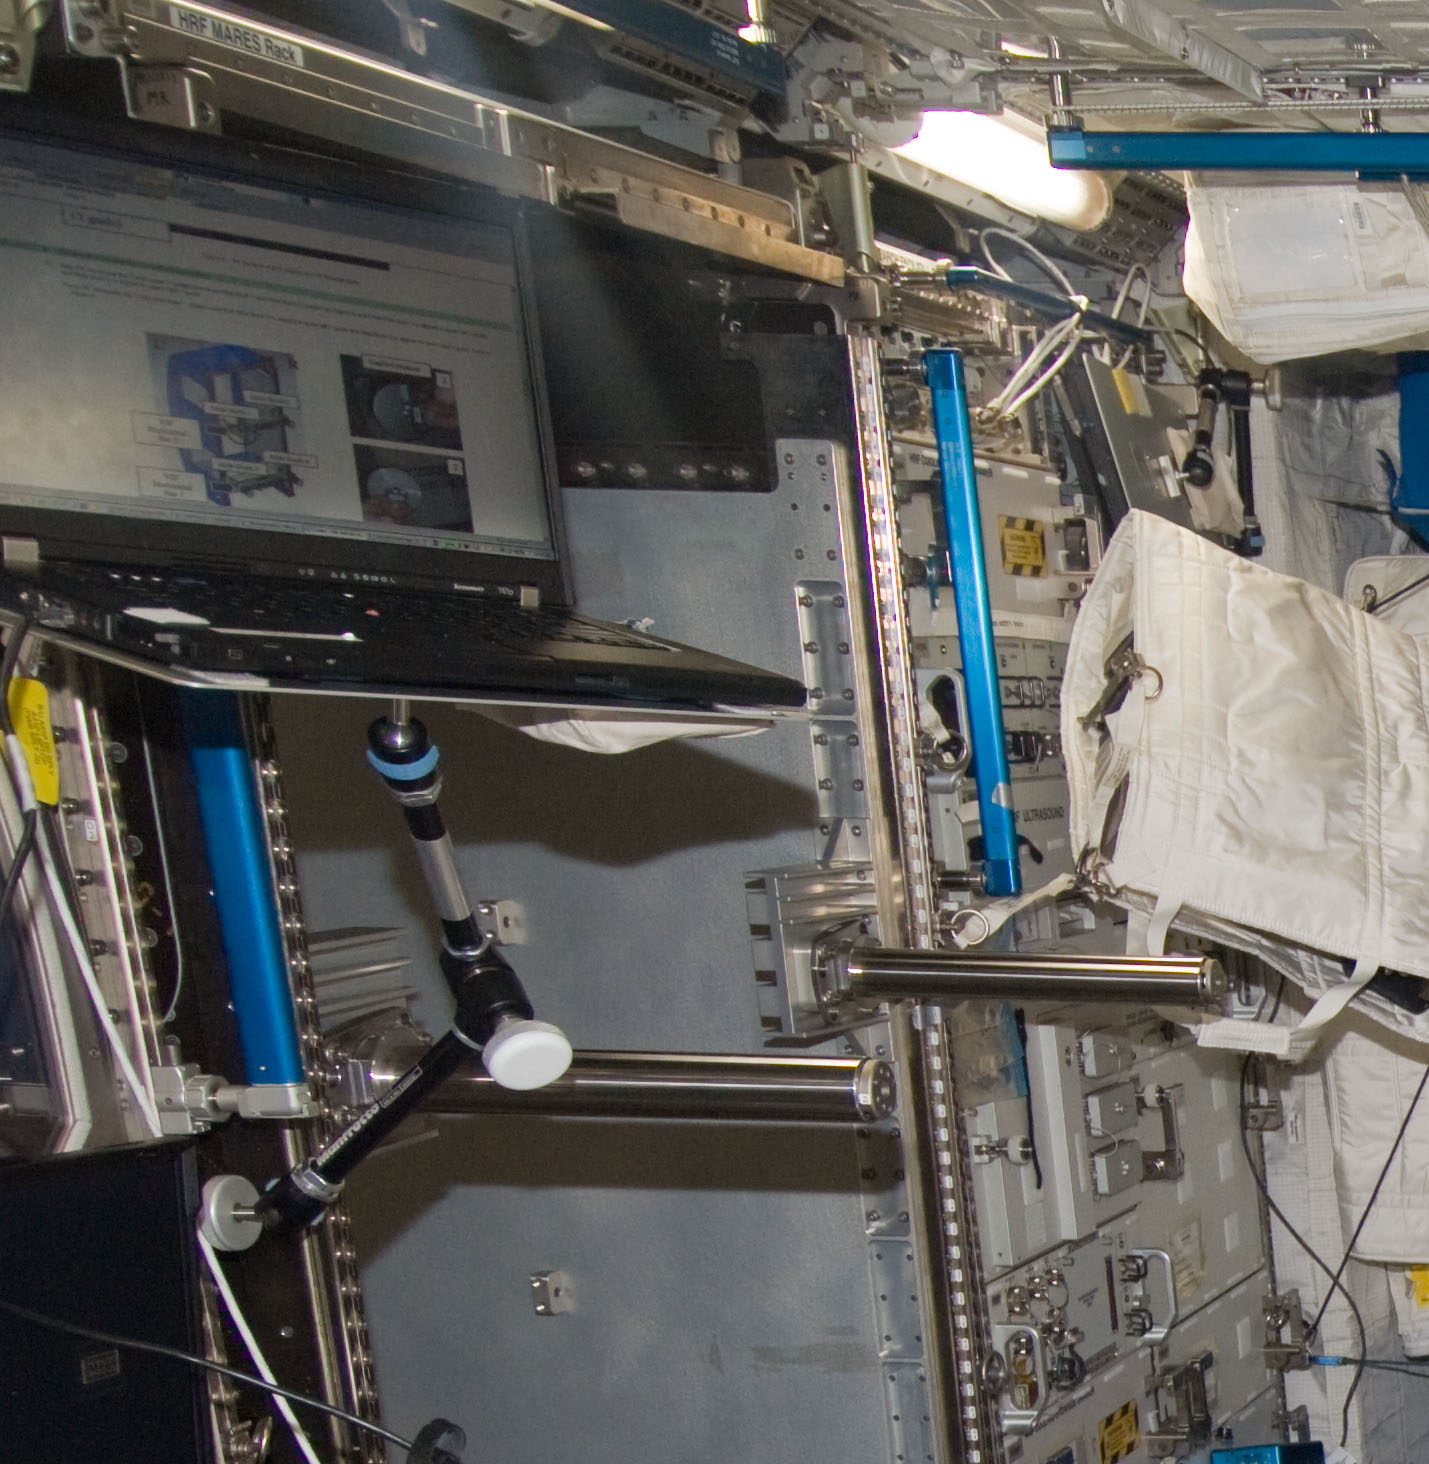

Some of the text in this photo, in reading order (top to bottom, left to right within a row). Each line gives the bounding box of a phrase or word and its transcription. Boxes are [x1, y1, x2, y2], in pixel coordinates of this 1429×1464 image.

[180, 10, 297, 62] HRF MARES Rack
